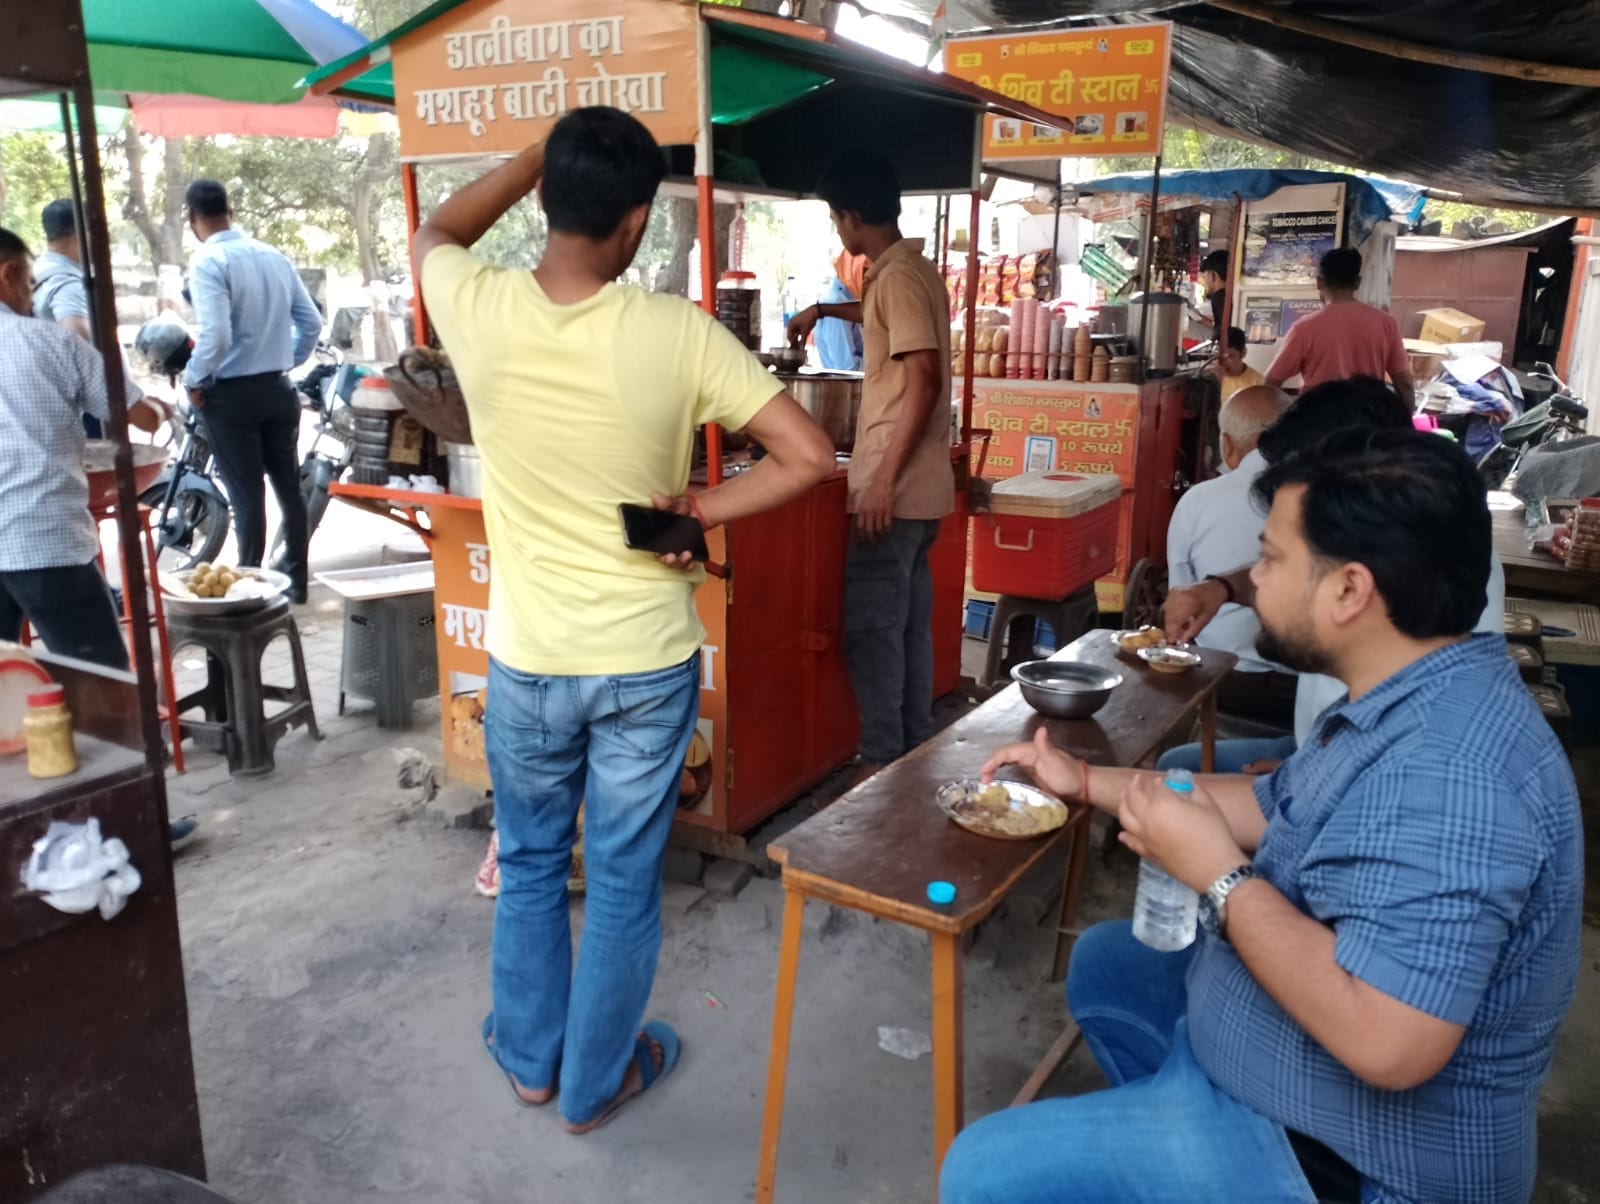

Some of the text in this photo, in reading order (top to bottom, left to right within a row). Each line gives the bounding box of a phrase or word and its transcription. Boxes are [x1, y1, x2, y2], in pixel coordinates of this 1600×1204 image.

[445, 15, 625, 70] डालीबाग का
[414, 84, 498, 136] मशहूर
[501, 67, 569, 120] बाटी
[1051, 69, 1074, 105] टी
[1080, 74, 1142, 104] स्टाल
[1272, 217, 1296, 227] TOBACCO
[1296, 216, 1317, 226] CAUSES
[1317, 216, 1337, 225] CANCE
[984, 410, 1024, 432] शिव
[1028, 412, 1050, 433] टी
[1056, 419, 1113, 439] स्टाल
[1062, 440, 1077, 452] 10
